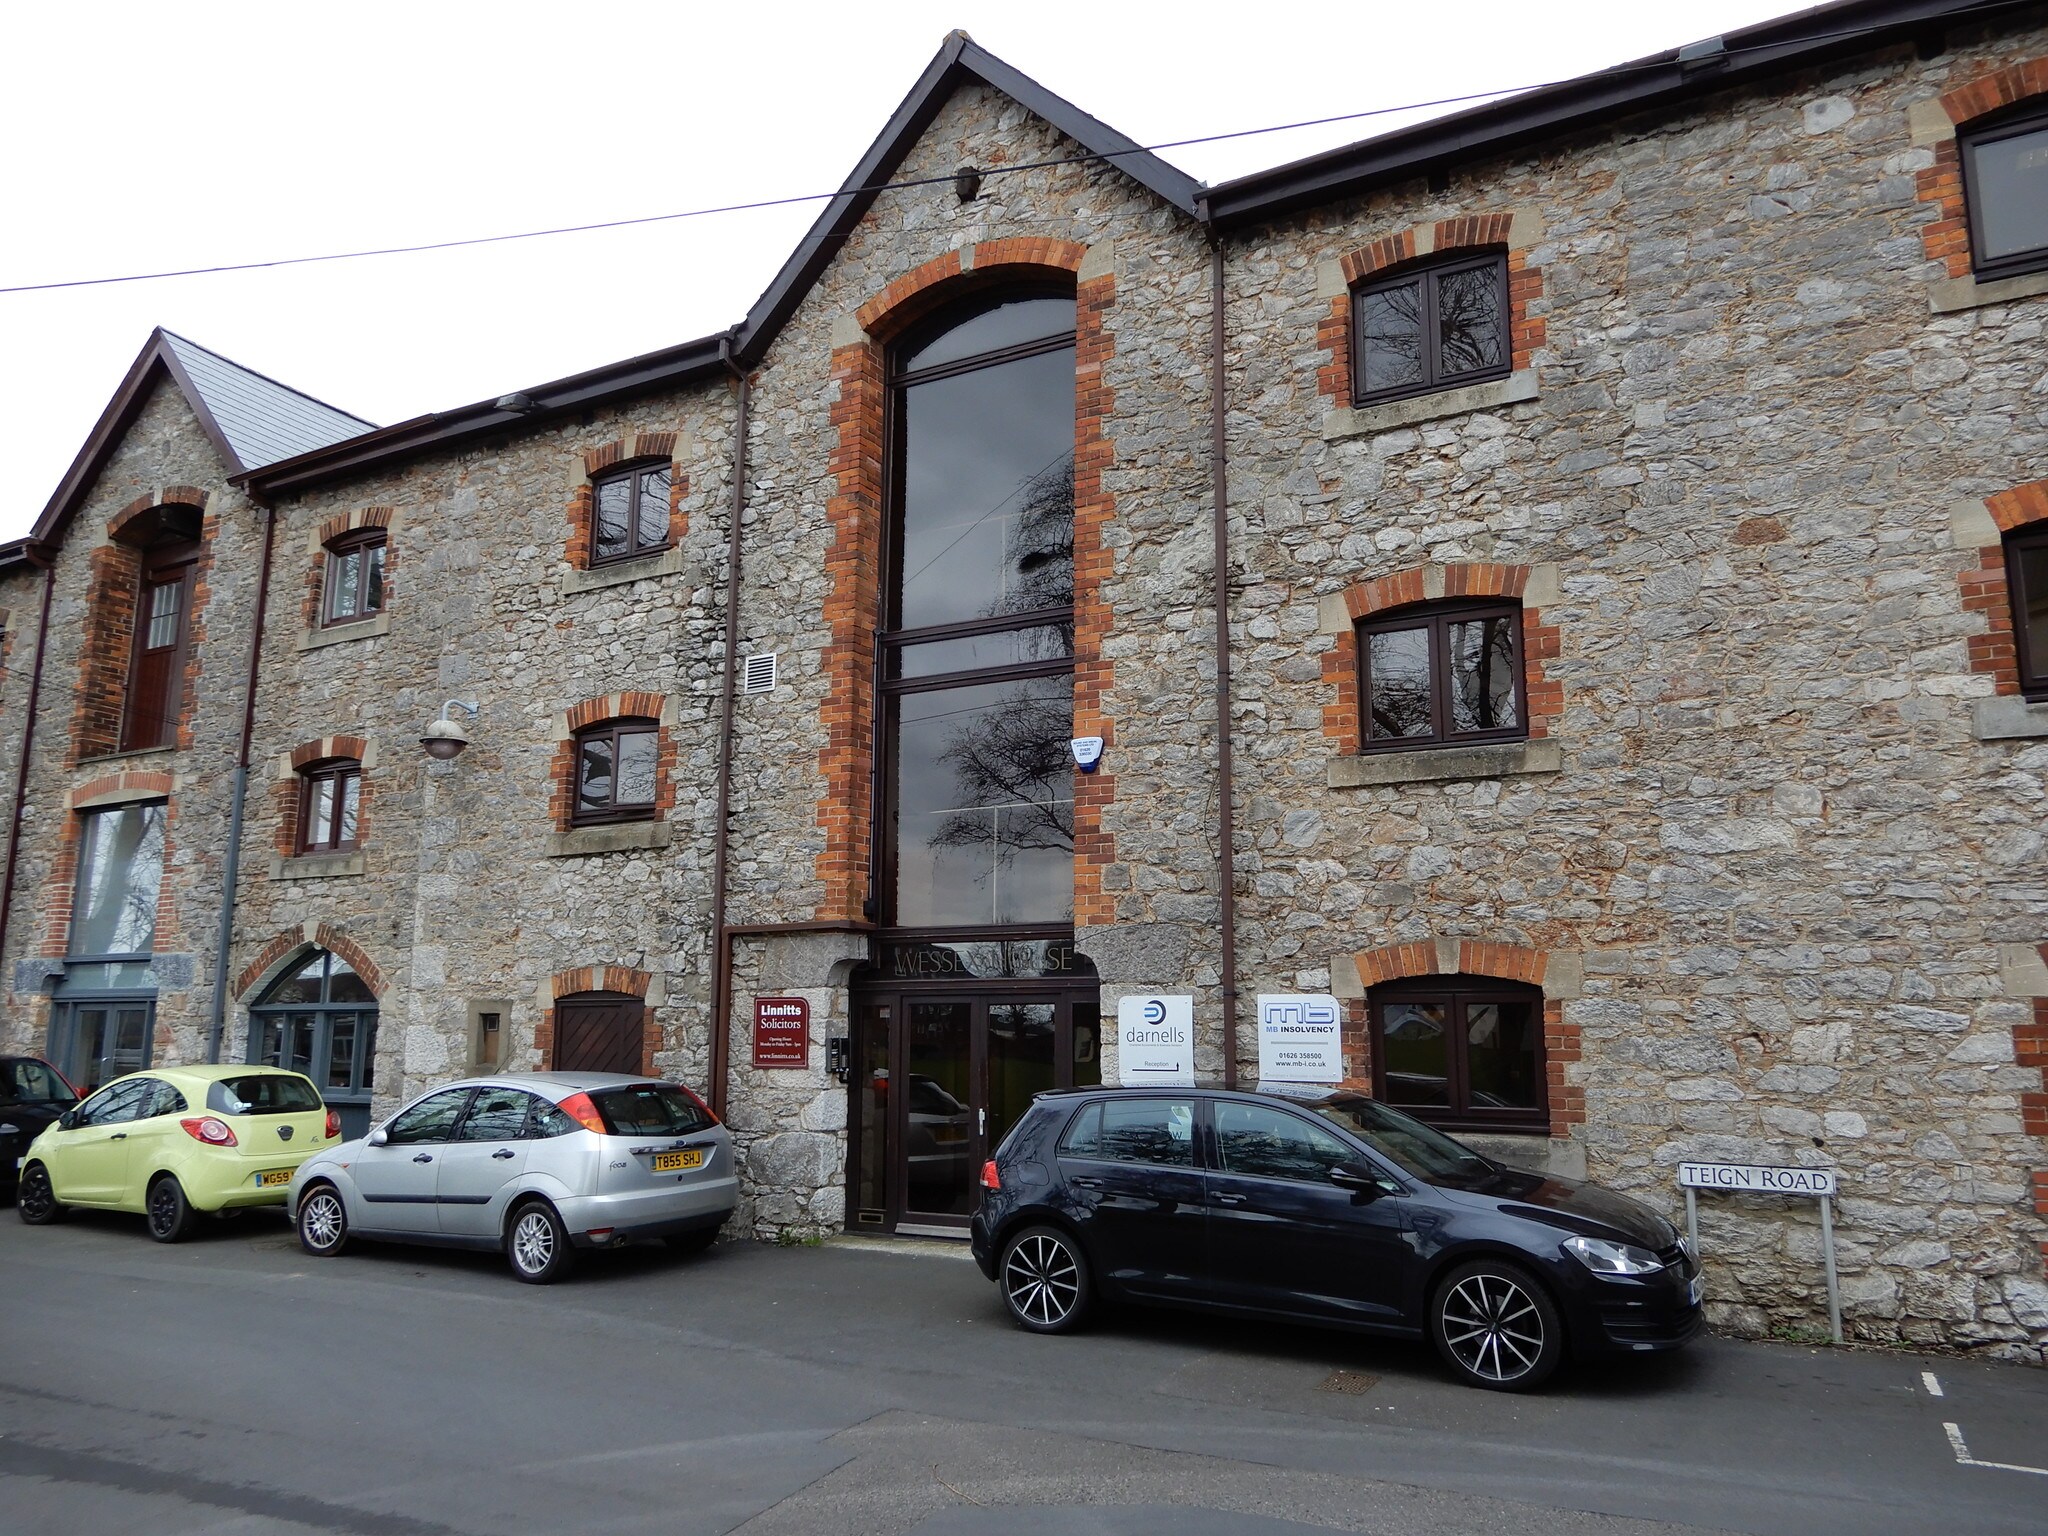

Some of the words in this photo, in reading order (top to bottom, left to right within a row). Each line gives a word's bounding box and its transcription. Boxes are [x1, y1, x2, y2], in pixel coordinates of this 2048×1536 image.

[895, 951, 981, 973] WESSEX
[761, 1005, 801, 1016] Linnitts
[761, 1018, 801, 1029] Solicitors
[1126, 1027, 1184, 1043] darnells
[657, 1155, 682, 1169] T855
[684, 1152, 701, 1166] SHJ
[263, 1172, 290, 1184] WG59
[1685, 1167, 1750, 1186] TEIGN
[1762, 1170, 1828, 1190] ROAD
